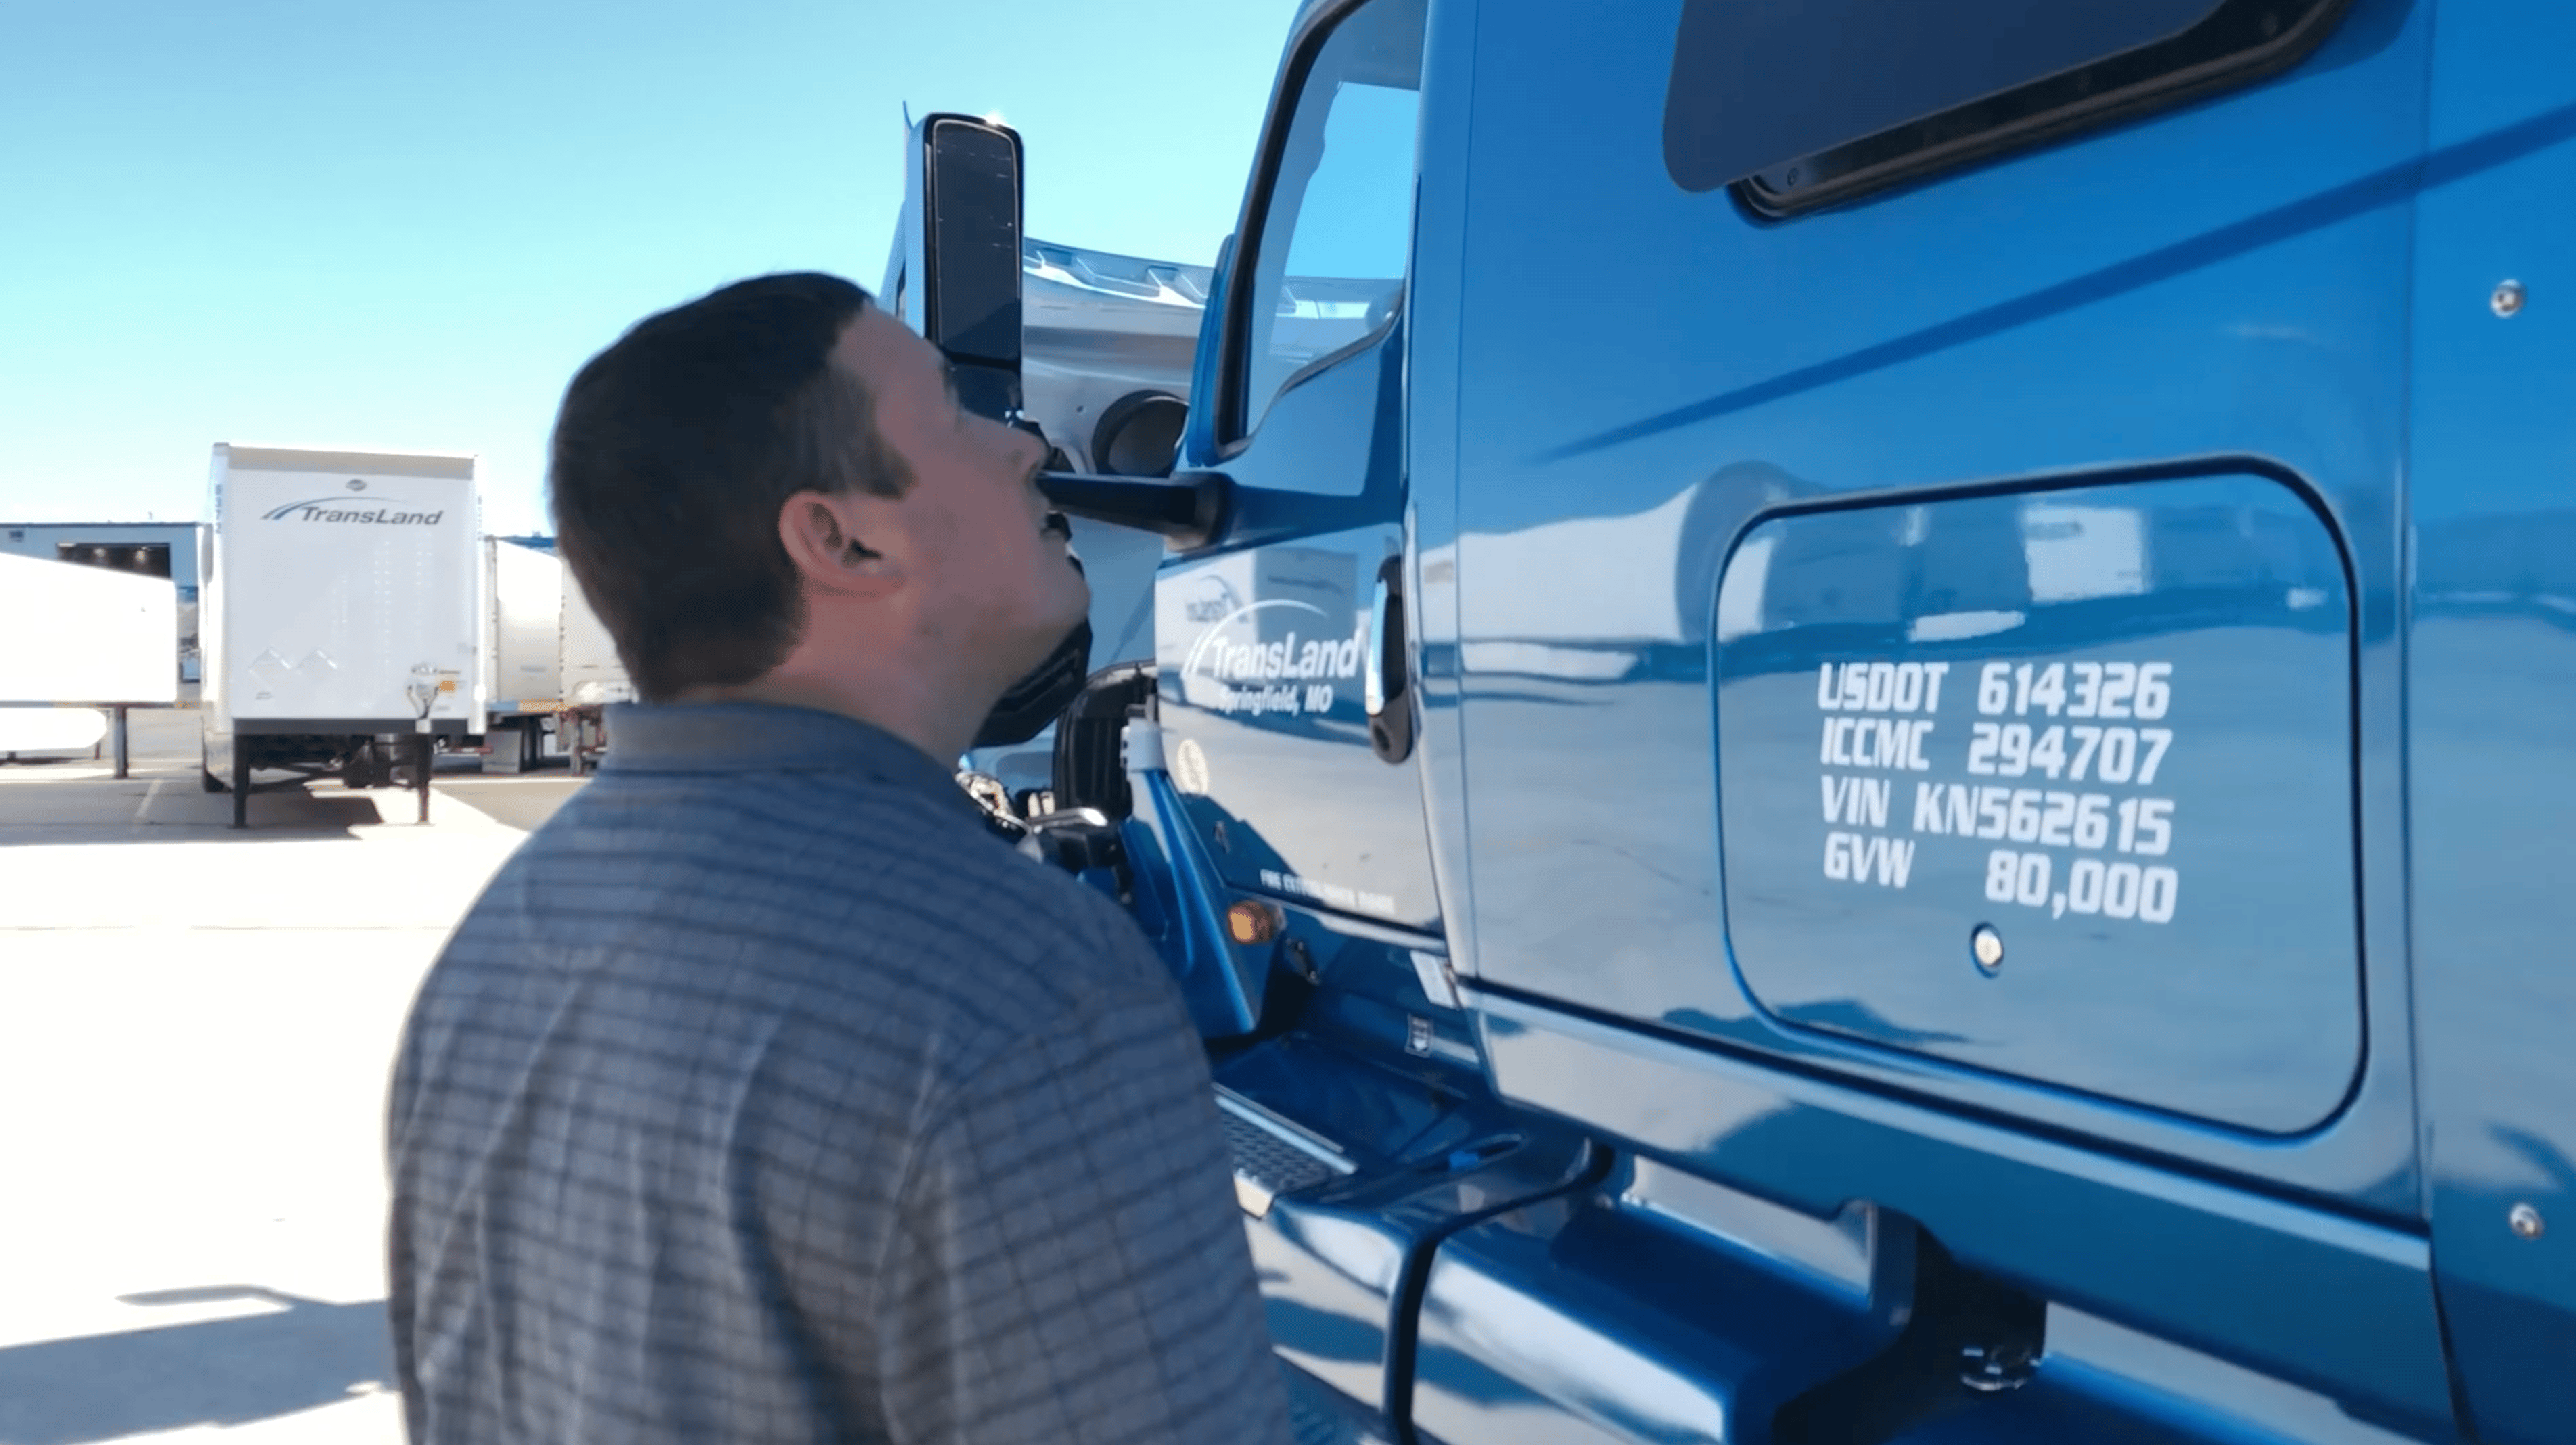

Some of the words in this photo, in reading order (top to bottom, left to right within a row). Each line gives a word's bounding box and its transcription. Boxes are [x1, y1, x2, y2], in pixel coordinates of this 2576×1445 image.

[302, 506, 444, 526] TransLand
[1212, 627, 1362, 679] TransLand
[1219, 684, 1300, 717] Springfield,
[1304, 684, 1334, 714] MO
[1818, 662, 1949, 712] USDOT
[1977, 662, 2173, 720] 614326
[1820, 717, 1933, 770] ICCMC
[1967, 722, 2172, 783] 294707
[1821, 775, 1890, 827] VIN
[1913, 782, 2174, 855] KN562615
[1824, 831, 1915, 887] GVW
[1985, 850, 2178, 923] 80,000
